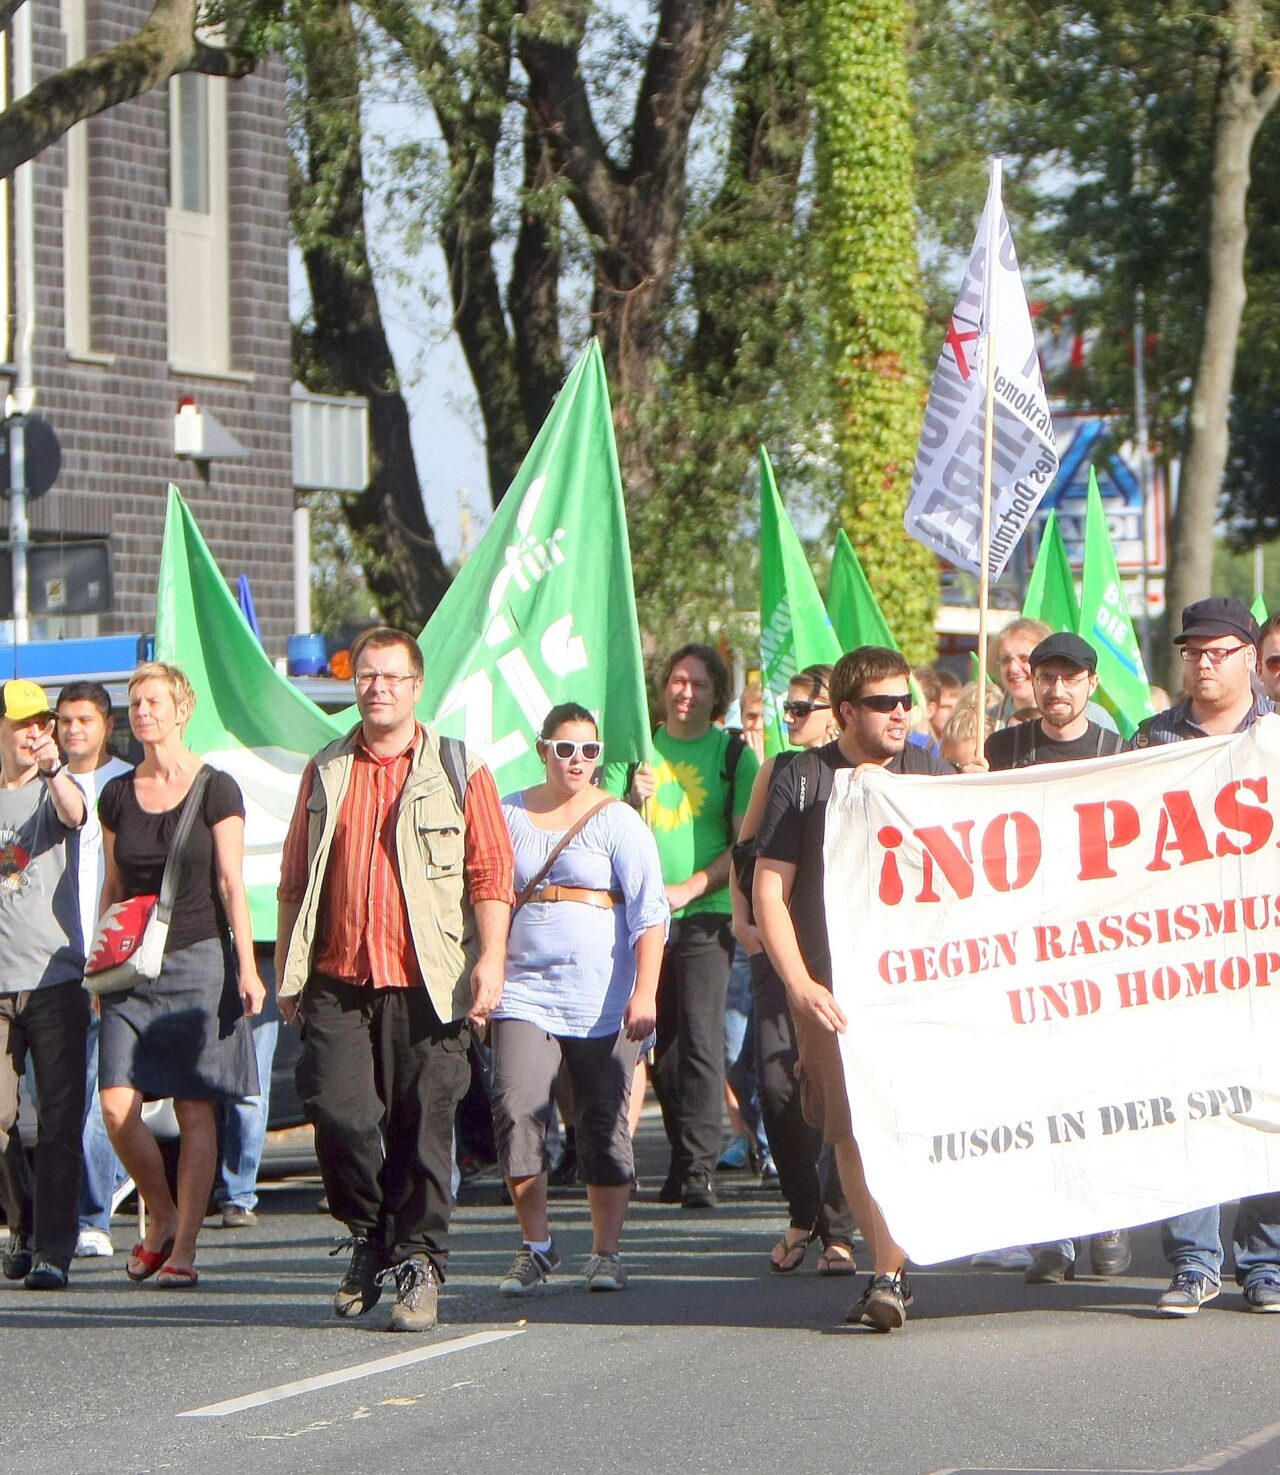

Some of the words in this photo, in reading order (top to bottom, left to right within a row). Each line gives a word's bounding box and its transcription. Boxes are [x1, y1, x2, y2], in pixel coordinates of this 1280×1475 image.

[505, 527, 567, 593] für
[877, 810, 1042, 905] ¡NO
[878, 930, 1018, 985] GEGEN
[1006, 978, 1101, 1025] UND
[928, 1120, 1034, 1164] JUSOS
[1046, 1110, 1086, 1144] IN
[1098, 1096, 1177, 1135] DER
[1187, 1085, 1253, 1120] SPD
